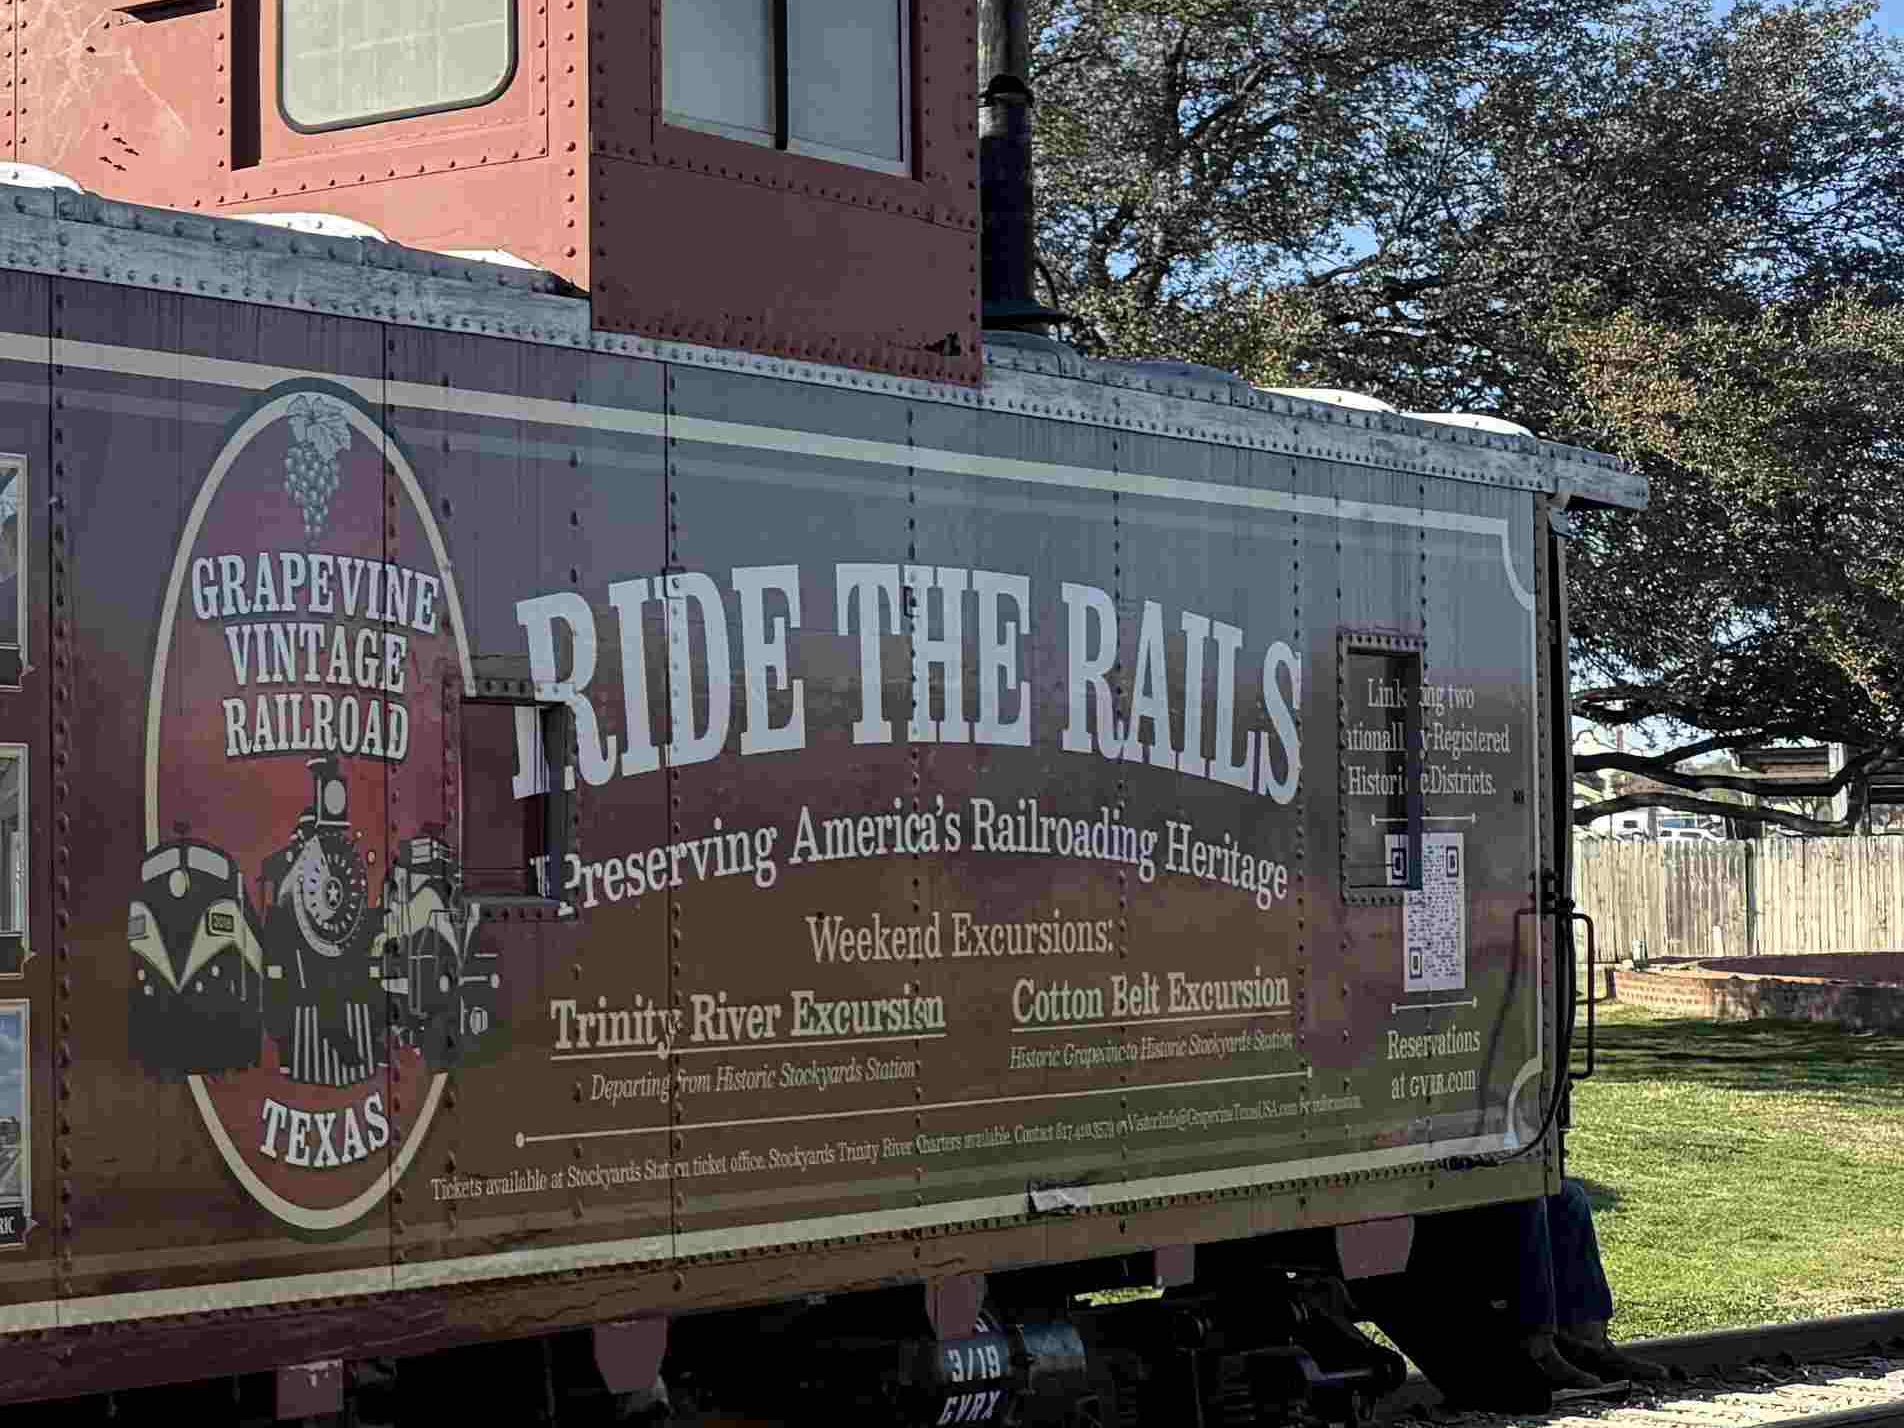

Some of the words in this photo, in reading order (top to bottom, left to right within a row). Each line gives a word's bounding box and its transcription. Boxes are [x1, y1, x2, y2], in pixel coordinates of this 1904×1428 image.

[192, 552, 439, 635] GRAPEVINE
[224, 623, 408, 693] VINTAGE
[512, 563, 806, 800] RIDE
[835, 563, 1032, 747] THE
[1060, 581, 1303, 805] RAILS
[1448, 684, 1474, 708] two
[222, 693, 409, 760] RAILROAD
[530, 818, 778, 916] Preserving
[789, 794, 960, 864] America's
[970, 797, 1157, 883] Railroading
[1166, 820, 1288, 910] Heritage
[806, 912, 941, 963] Weekend
[952, 908, 1113, 957] Excursions:
[550, 994, 682, 1060] Trinity
[690, 992, 781, 1042] River
[791, 982, 946, 1036] Excursion
[1012, 978, 1104, 1022] Cotton
[1111, 972, 1160, 1016] Belt
[1167, 966, 1290, 1013] Excursion
[1011, 1045, 1060, 1069] Historic
[1141, 1035, 1185, 1060] Historic
[1387, 1023, 1480, 1060] Reservations
[591, 1072, 670, 1105] Departing
[674, 1068, 710, 1096] from
[715, 1061, 775, 1092] Historic
[780, 1056, 863, 1092] Stockyards
[866, 1054, 916, 1080] Station
[1392, 1072, 1405, 1100] at
[260, 1091, 390, 1167] TEXAS
[431, 1177, 481, 1201] Tickets
[486, 1170, 545, 1195] available
[551, 1171, 564, 1189] at
[568, 1161, 640, 1190] Stockyards
[644, 1158, 689, 1181] Station
[693, 1152, 728, 1174] ticket
[768, 1142, 834, 1172] Stockyards
[838, 1140, 880, 1165] Trinity
[882, 1138, 912, 1158] River
[948, 1345, 1000, 1382] 3/19
